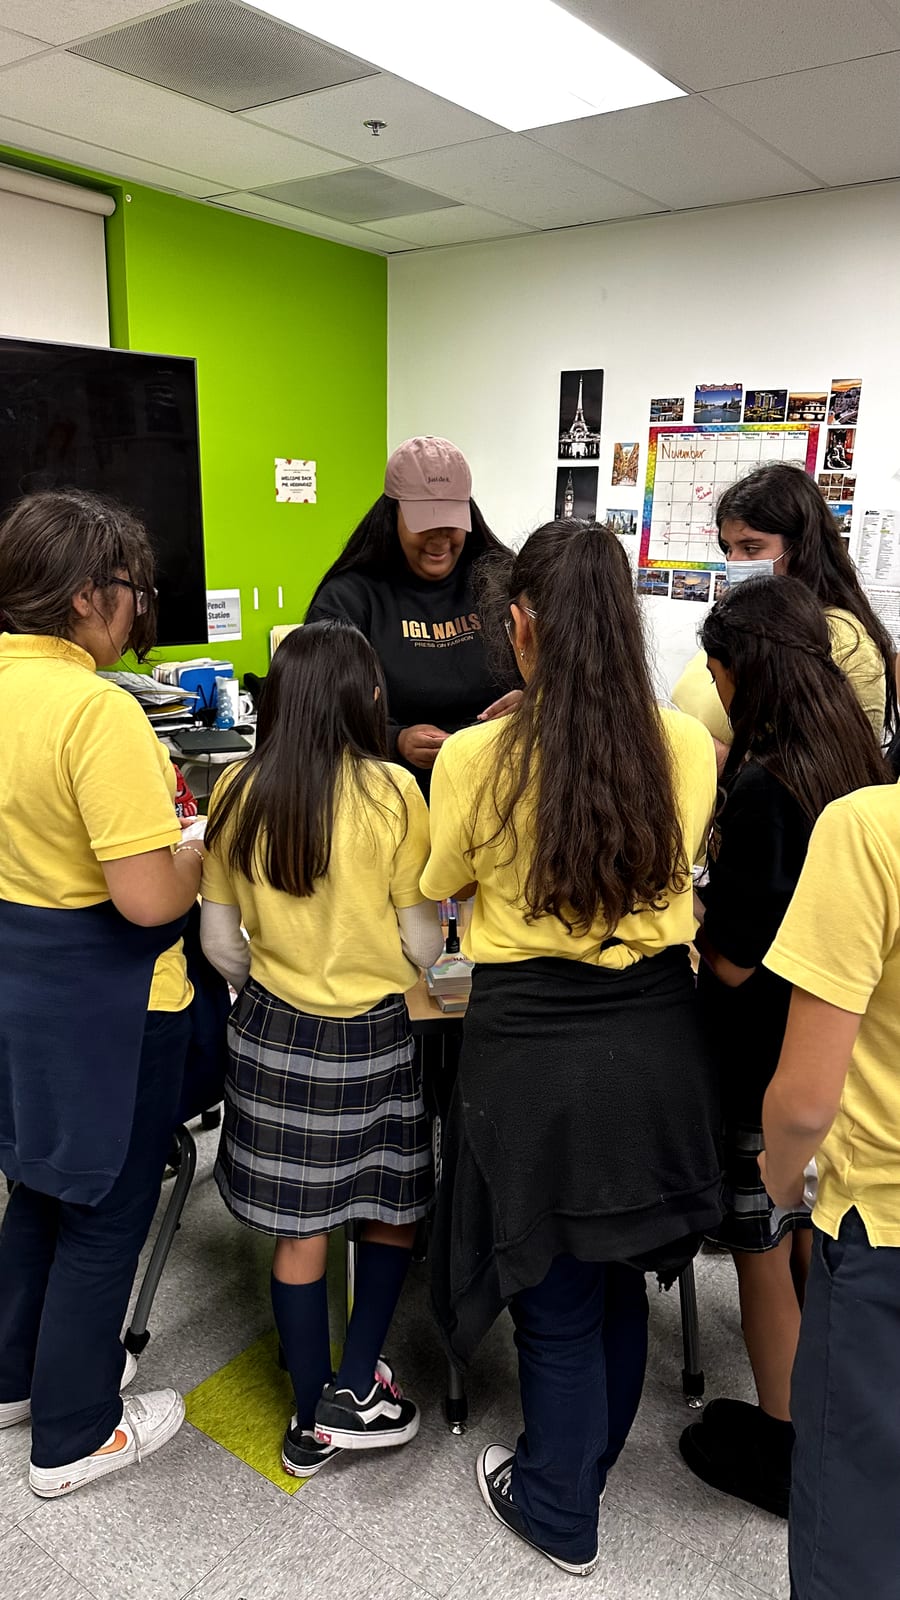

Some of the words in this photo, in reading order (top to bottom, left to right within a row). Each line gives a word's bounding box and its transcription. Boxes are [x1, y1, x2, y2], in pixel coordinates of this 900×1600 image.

[661, 442, 706, 460] November
[208, 601, 226, 610] Pencil
[208, 611, 230, 620] Station
[402, 619, 431, 639] IGL
[432, 613, 482, 640] NAILS
